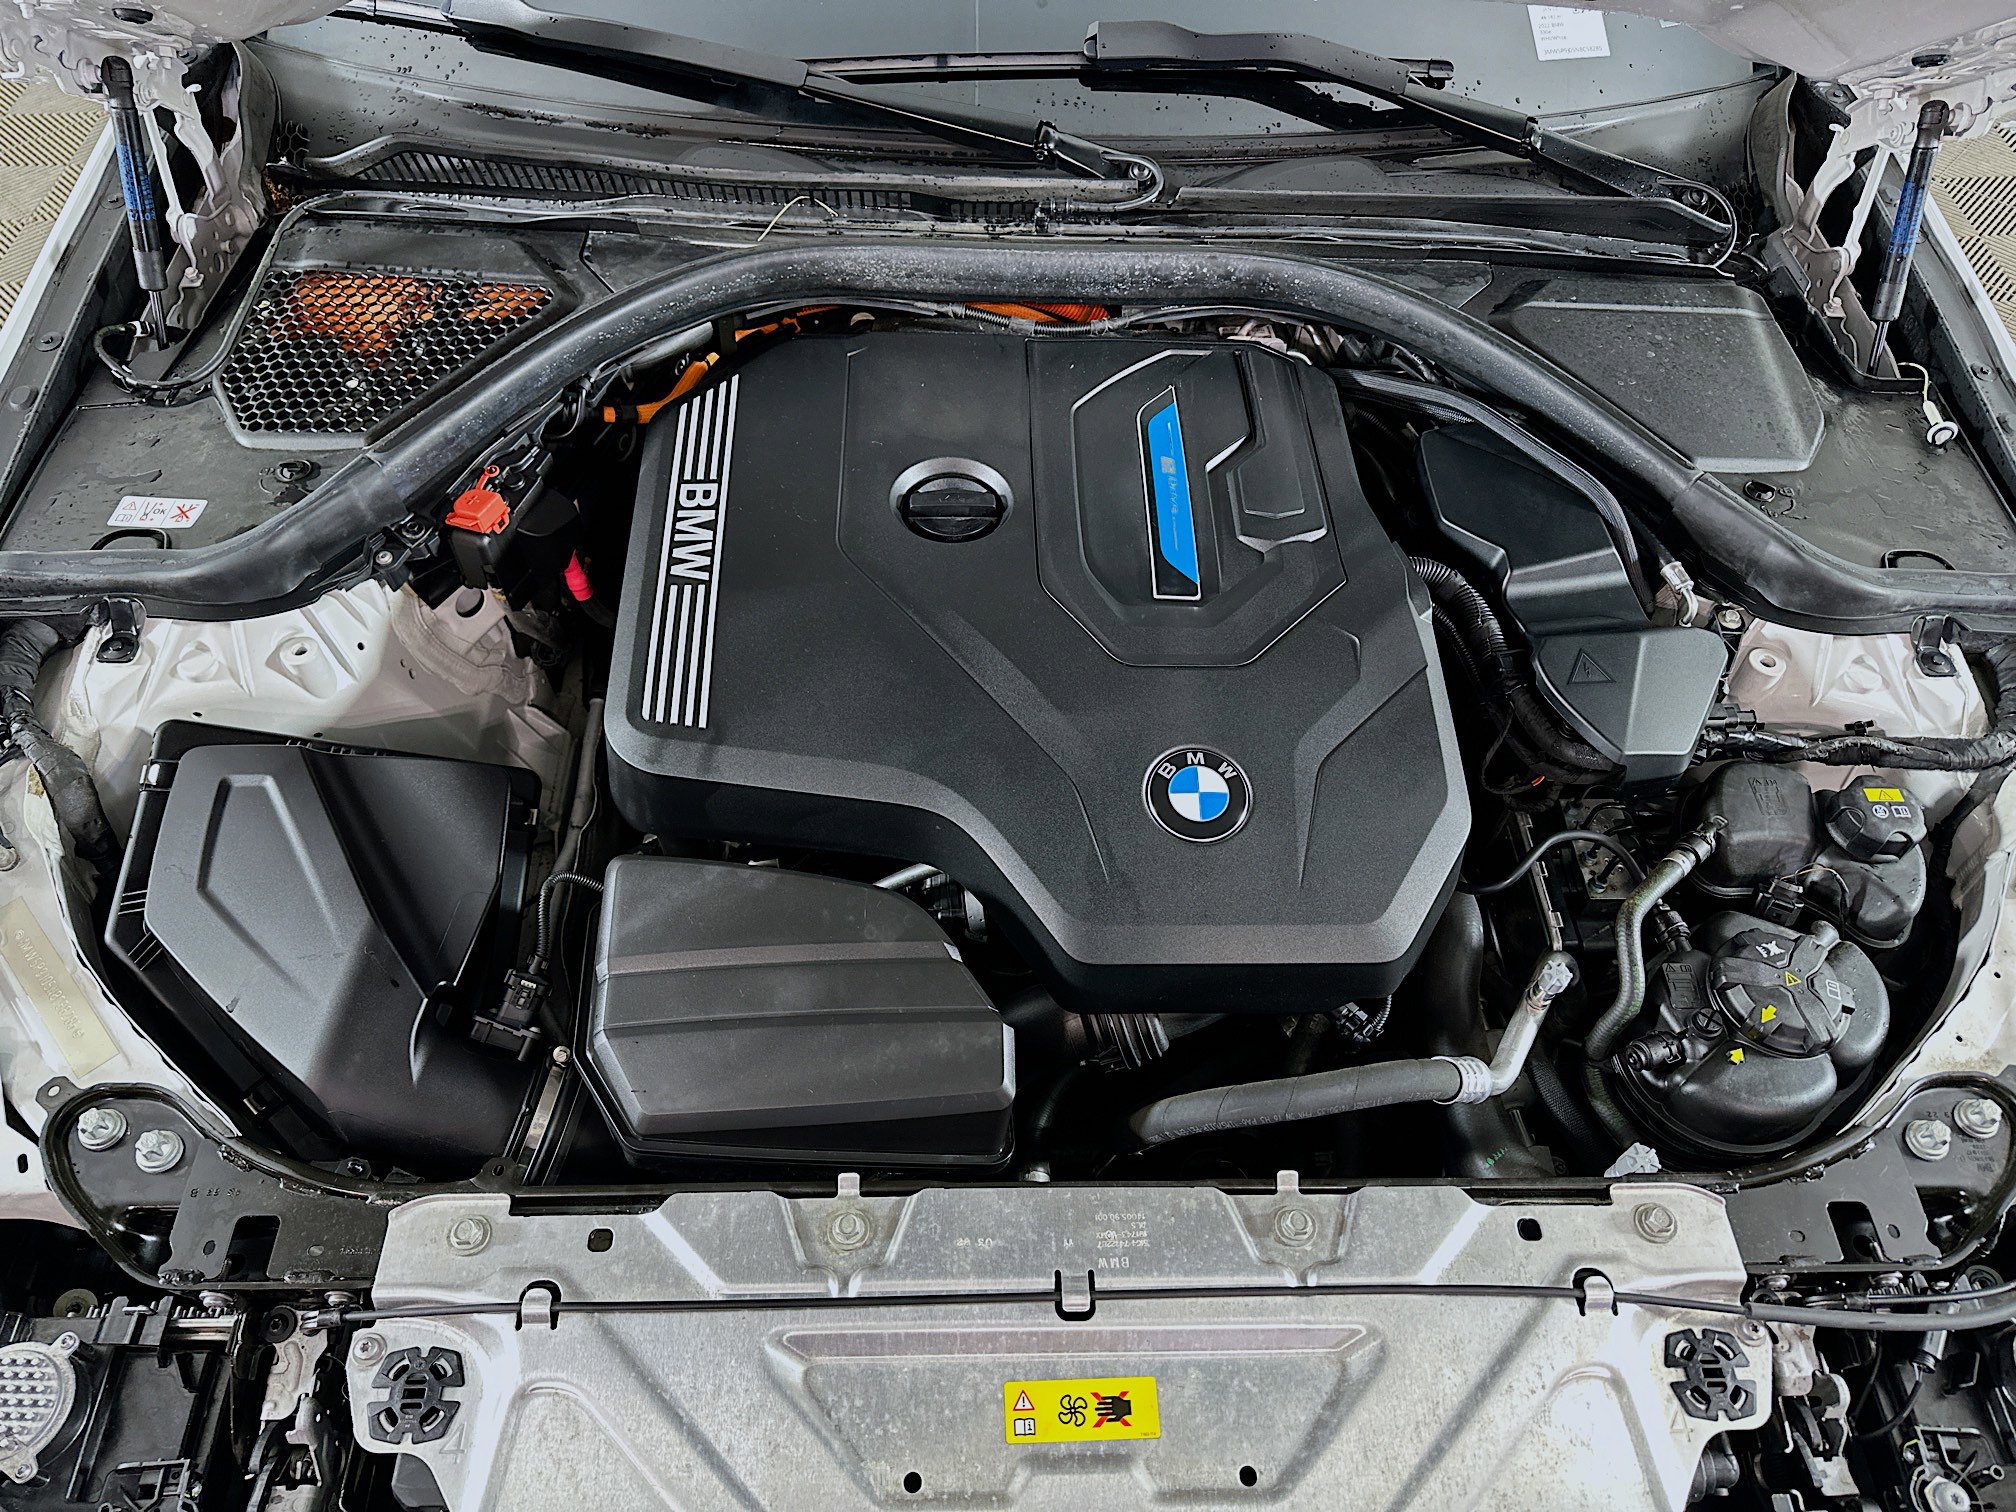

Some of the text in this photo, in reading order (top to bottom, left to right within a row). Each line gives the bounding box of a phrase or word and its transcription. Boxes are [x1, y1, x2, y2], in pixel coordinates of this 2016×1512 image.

[669, 482, 719, 581] BMW
[1157, 751, 1238, 780] BMW
[1098, 1256, 1130, 1269] BMW
